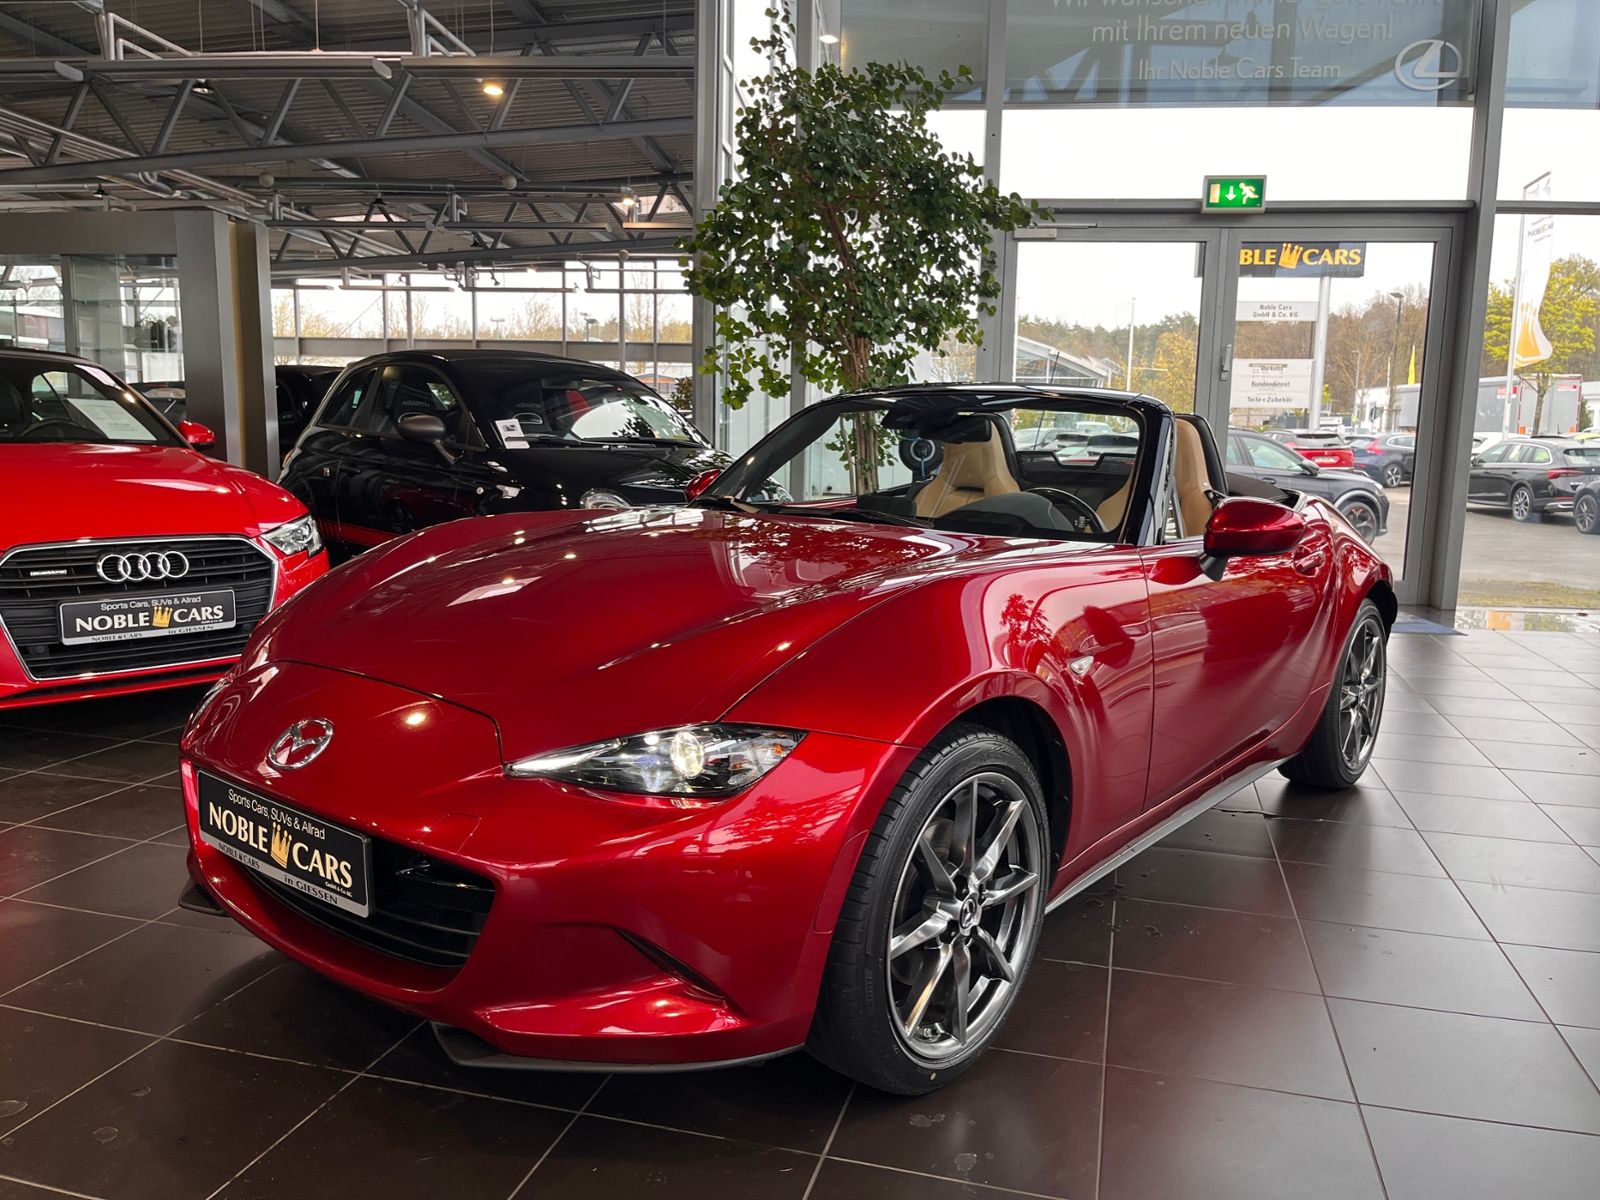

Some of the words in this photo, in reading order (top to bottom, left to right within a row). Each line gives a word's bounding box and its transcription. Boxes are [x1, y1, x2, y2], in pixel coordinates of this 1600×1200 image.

[1092, 20, 1129, 42] mit
[1137, 14, 1207, 42] Ihrem
[1214, 22, 1290, 41] neuen
[1300, 12, 1393, 45] Wagen!
[1138, 58, 1167, 80] Ihr
[1169, 58, 1231, 80] Noble
[1236, 57, 1284, 80] Cars
[1290, 56, 1341, 79] Team
[1302, 248, 1361, 266] CARS
[1253, 311, 1270, 319] GmbH
[1289, 311, 1298, 319] KG
[1259, 303, 1277, 311] Noble
[1278, 303, 1293, 311] Cars
[101, 602, 128, 612] Sports
[151, 598, 173, 607] SUVs
[174, 597, 180, 605] &
[181, 596, 201, 604] Allrad
[75, 611, 150, 632] NOBLE
[173, 605, 224, 623] CARS
[228, 788, 251, 808] Sports
[251, 799, 270, 820] Cars,
[270, 807, 293, 828] SUVs
[293, 817, 301, 830] &
[301, 820, 326, 840] Allrad
[209, 801, 268, 854] NOBLE
[292, 842, 353, 888] CARS
[218, 842, 238, 858] NOBLE
[243, 855, 260, 869] CARS
[284, 874, 293, 886] in
[296, 880, 338, 905] GIESSEN
